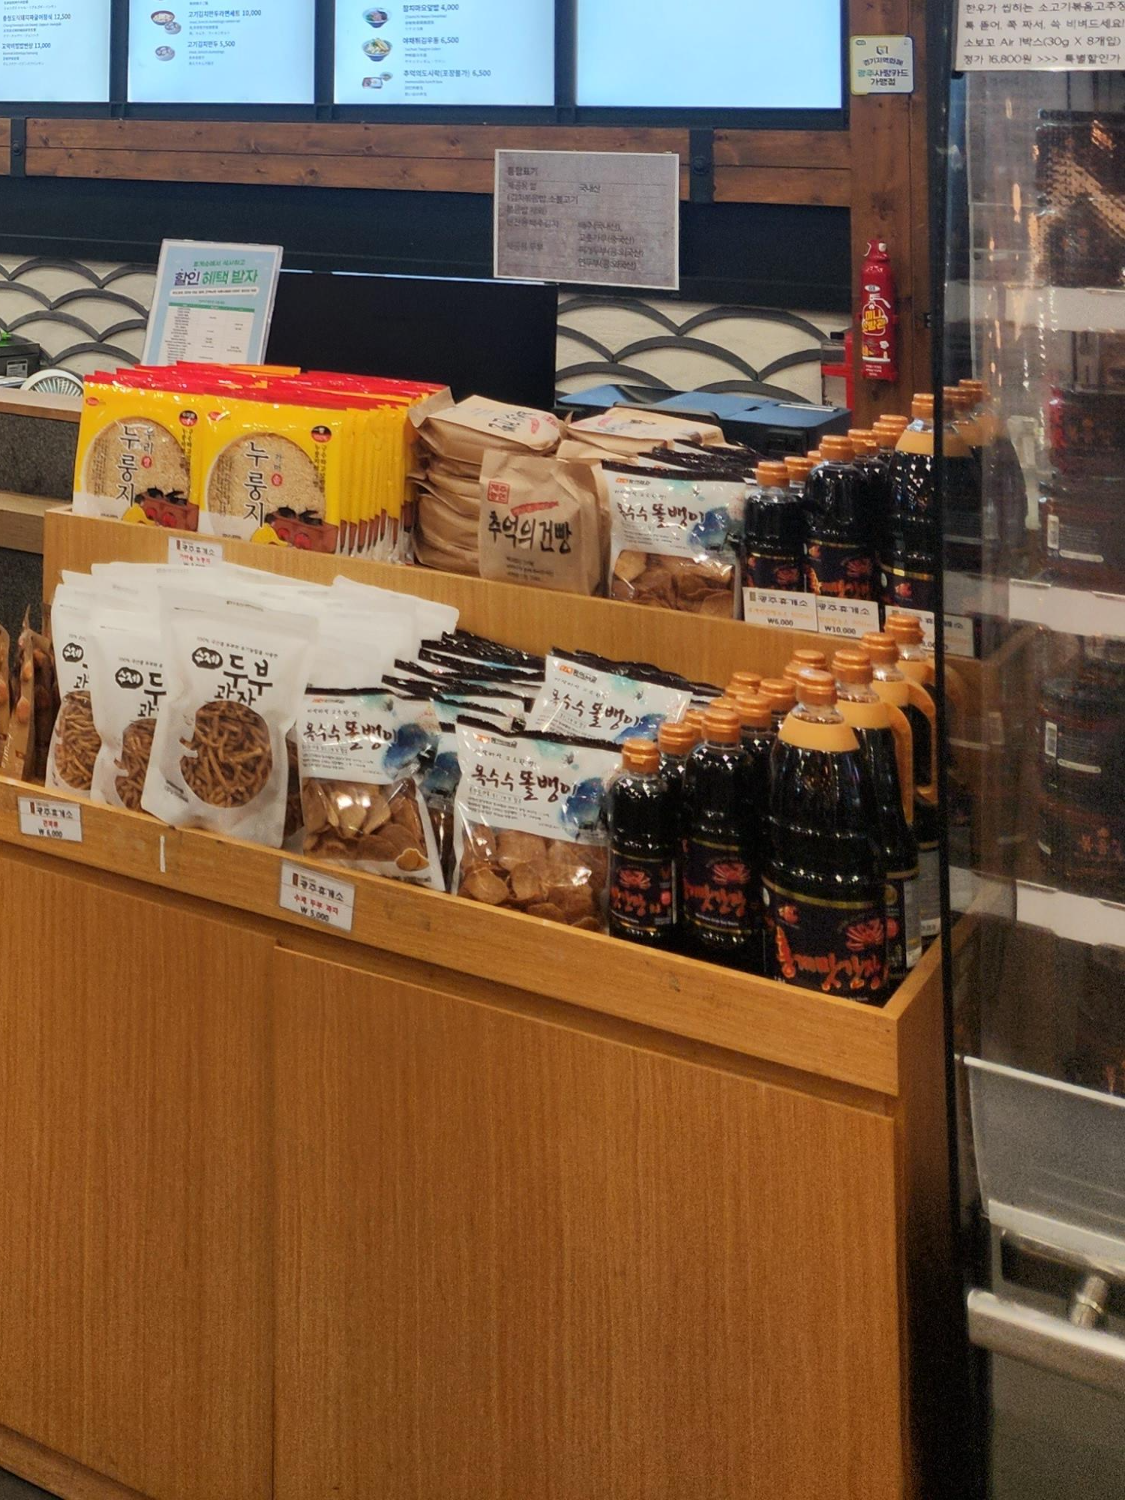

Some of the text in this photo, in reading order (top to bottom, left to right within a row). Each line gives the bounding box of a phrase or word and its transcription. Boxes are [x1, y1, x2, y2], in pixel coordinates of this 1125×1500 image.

[188, 9, 262, 18] 고기김치만두라면세트 10,000
[402, 3, 459, 13] 참치마요덮밥 4,000
[965, 2, 997, 14] 한우가
[1001, 1, 1034, 14] 씹히는
[1065, 18, 1125, 30] 비벼드세요!
[187, 40, 235, 48] 고기김치만두 5,500
[402, 36, 460, 45] 야채튀김우동 6,500
[999, 37, 1015, 47] Air
[1018, 36, 1069, 49] 1박스(30g
[1074, 37, 1082, 47] X
[1086, 35, 1121, 48] 8개입)
[962, 54, 984, 66] 정가
[988, 53, 1033, 65] 16,800원
[1064, 53, 1120, 65] 특별할인가
[472, 69, 492, 77] 6,500
[857, 69, 909, 78] 광주사랑카드
[870, 78, 896, 86] 가맹점
[578, 183, 601, 194] 국내산
[174, 268, 259, 287] 할인 혜택 받자
[115, 425, 140, 508] 누룽지
[243, 441, 269, 528] 누룽지
[616, 502, 648, 522] 옥수수
[488, 510, 572, 554] 추억의 건빵
[758, 595, 808, 608] 광주휴게소
[767, 617, 794, 627] ₩6,000
[824, 624, 857, 636] ₩10,000
[196, 650, 221, 666] 수제
[118, 669, 141, 685] 수제
[223, 654, 273, 696] 두부
[143, 671, 167, 706] 두
[214, 682, 257, 706] 과자
[549, 688, 585, 717] 옥수수
[303, 721, 341, 743] 옥수수
[471, 763, 514, 792] 옥수수
[37, 806, 73, 819] 광주휴게소
[38, 827, 44, 835] ₩
[300, 880, 344, 902] 광주휴게소
[293, 894, 339, 916] 수제 두부 과자
[300, 906, 330, 922] ₩ 5,000
